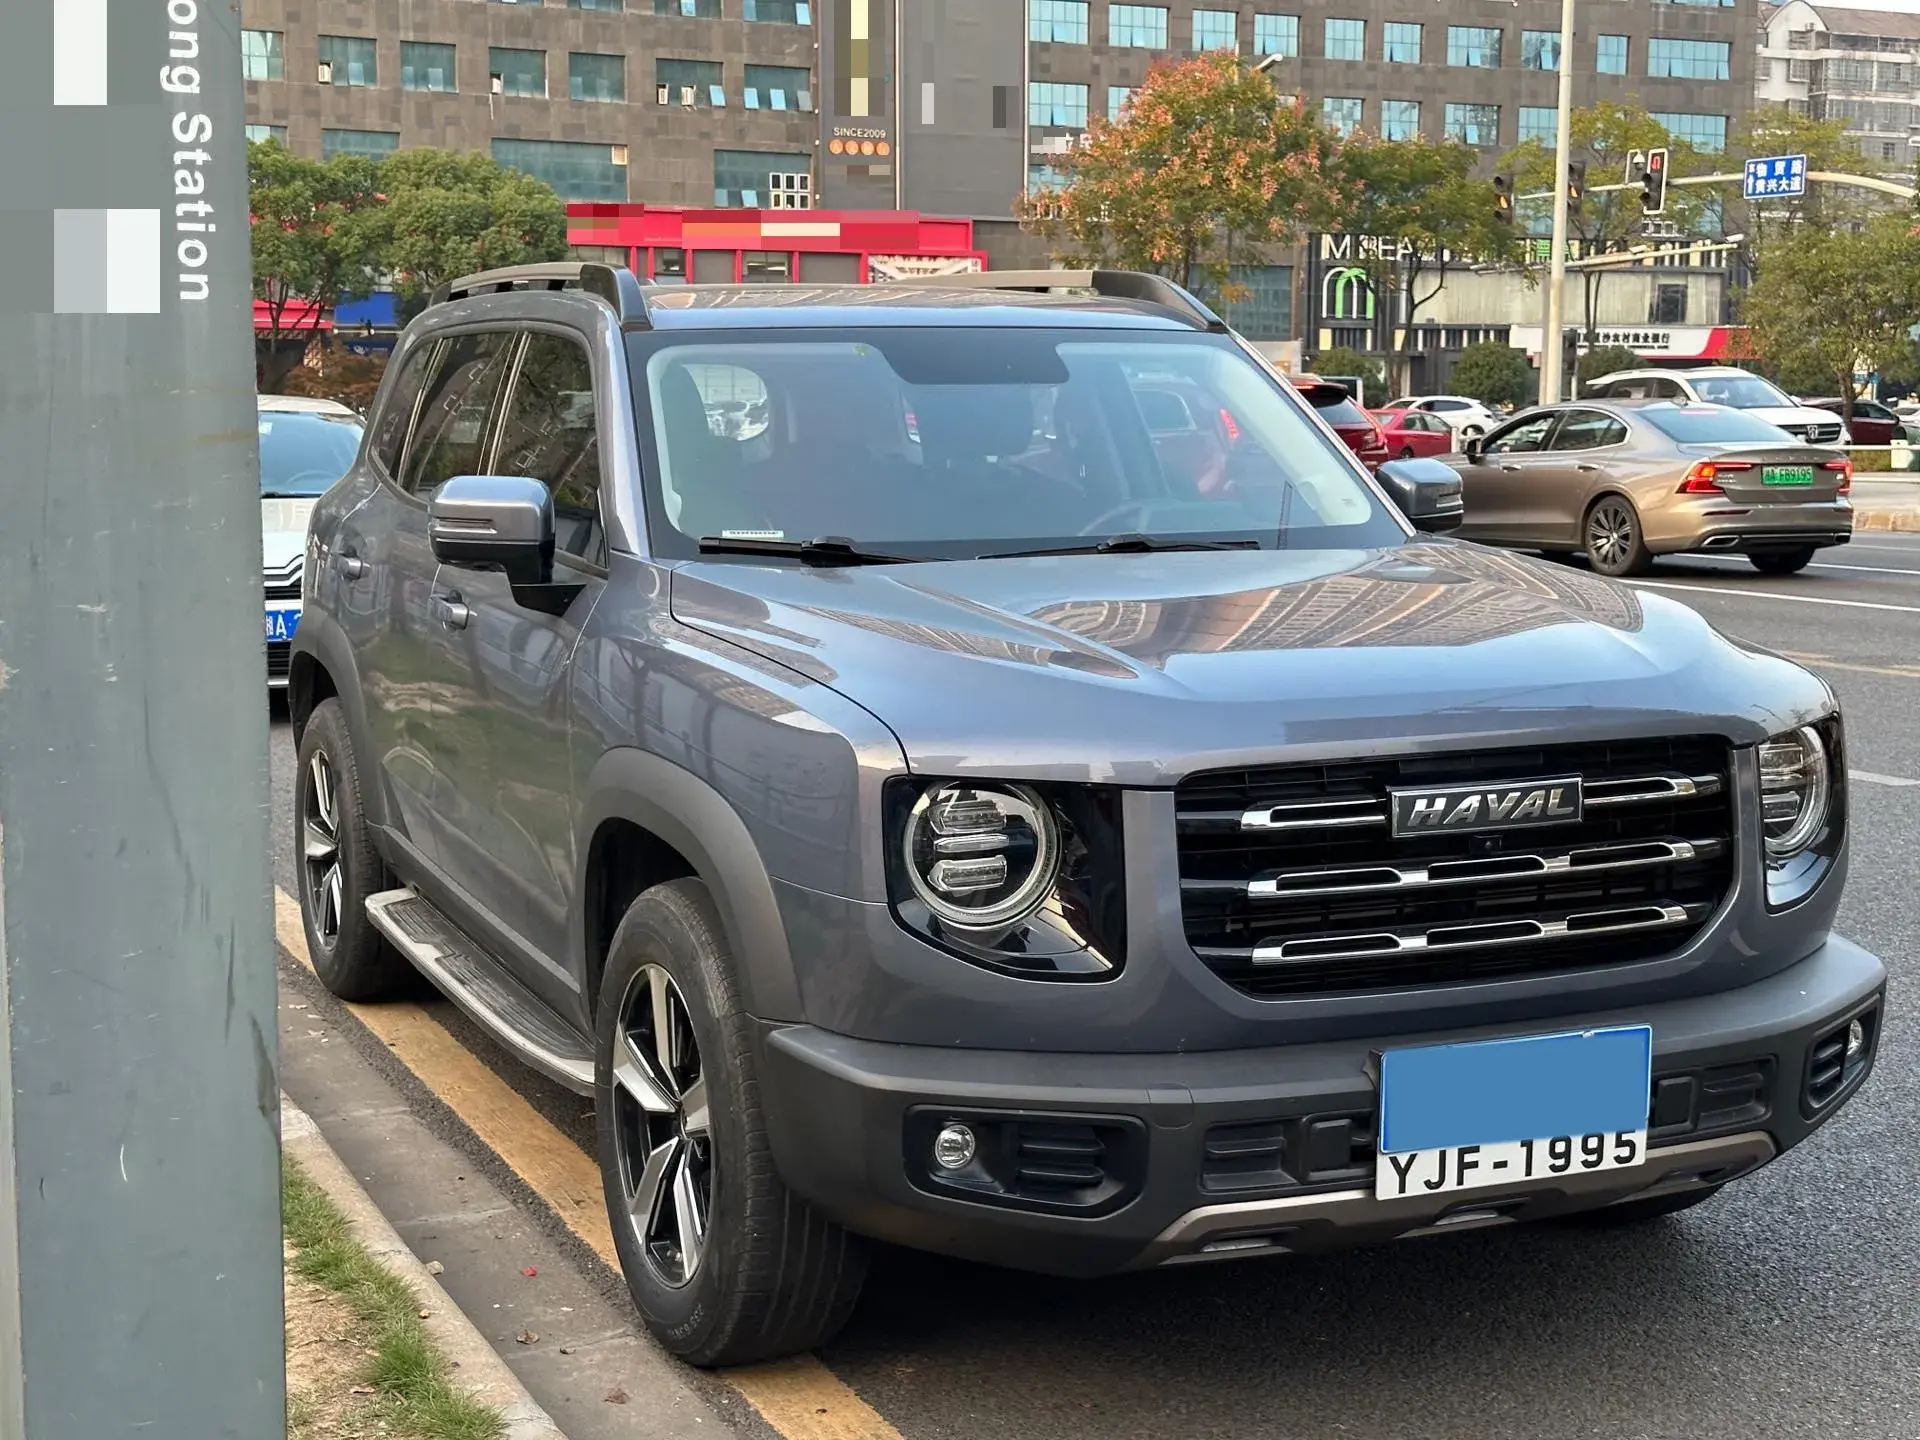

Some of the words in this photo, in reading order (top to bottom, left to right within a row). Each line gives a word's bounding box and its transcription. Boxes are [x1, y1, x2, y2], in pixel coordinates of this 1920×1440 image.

[833, 127, 887, 139] SINCE2009
[172, 112, 216, 301] Station
[1407, 787, 1575, 827] HAVAL
[1388, 1128, 1637, 1194] YJF-1995
